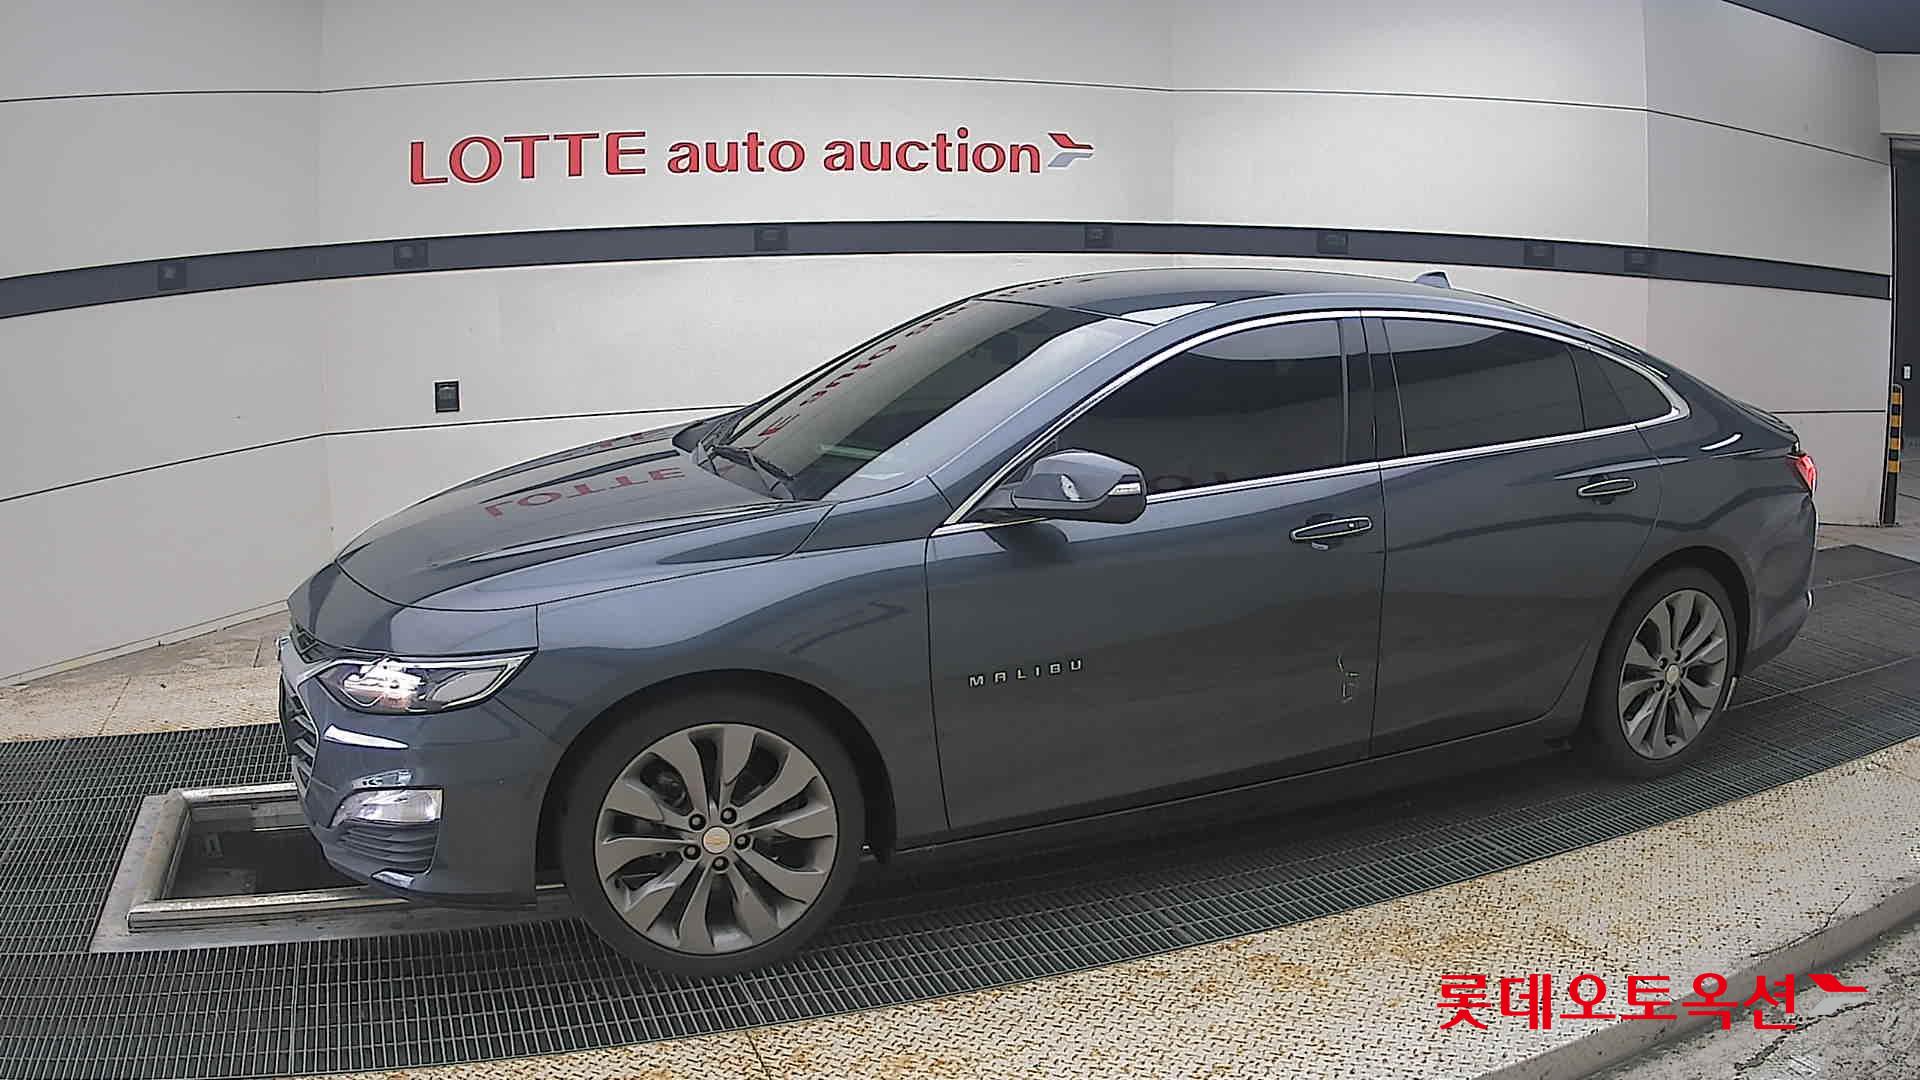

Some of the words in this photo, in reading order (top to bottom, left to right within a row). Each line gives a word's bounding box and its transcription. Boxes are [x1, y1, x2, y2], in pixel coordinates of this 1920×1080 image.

[409, 131, 645, 186] LOTTE
[667, 131, 806, 174] auto
[823, 127, 1041, 173] auction
[968, 659, 1083, 688] MALIBU
